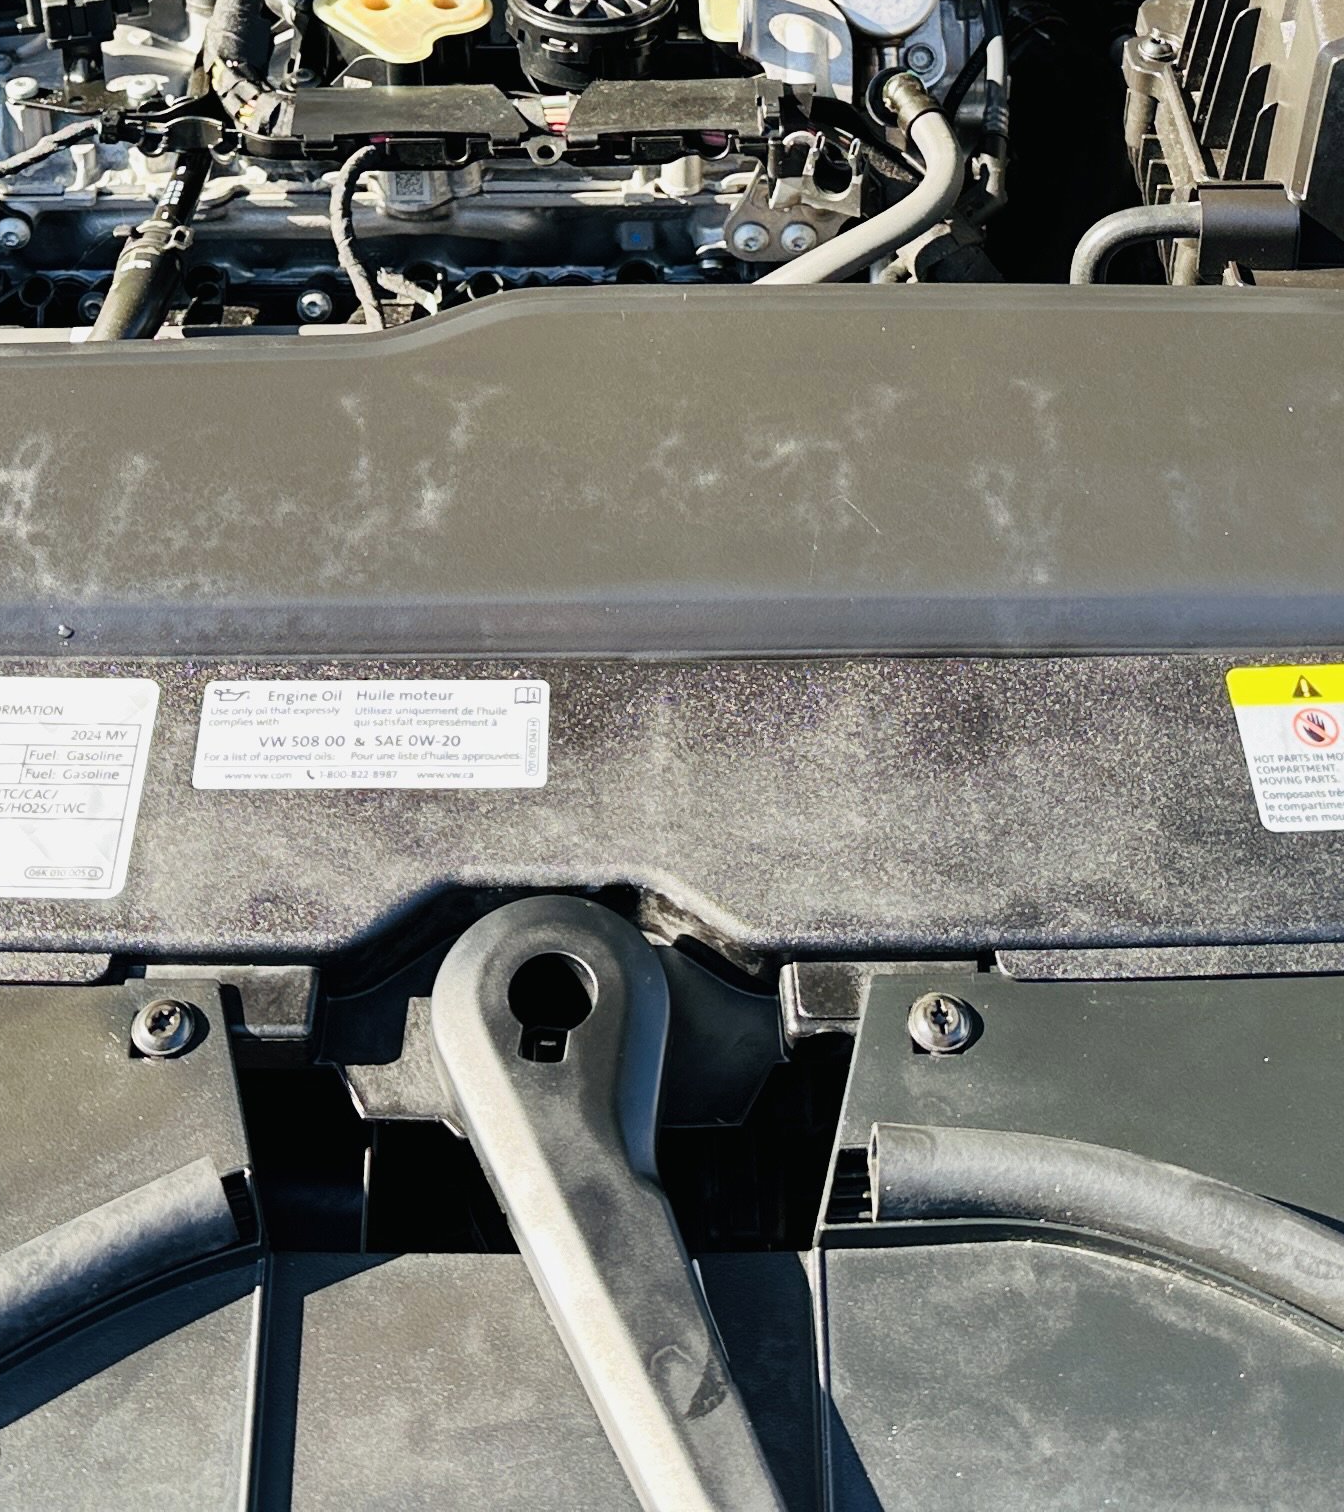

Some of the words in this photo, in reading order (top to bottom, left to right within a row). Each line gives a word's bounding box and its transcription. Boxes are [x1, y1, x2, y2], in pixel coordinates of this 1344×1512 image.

[268, 690, 317, 705] Engine
[322, 690, 342, 701] Oil
[356, 690, 395, 701] Huile
[399, 690, 454, 701] moteur
[232, 708, 252, 716] only
[271, 707, 291, 715] that
[294, 707, 340, 716] expressly
[355, 707, 393, 716] Utilisez
[395, 707, 458, 717] uniquement
[461, 707, 474, 716] de
[209, 719, 253, 727] complies
[354, 719, 370, 727] qui
[373, 718, 413, 727] satisfait
[491, 718, 497, 727] à
[71, 730, 101, 741] 2024
[106, 730, 127, 741] MY
[259, 737, 287, 747] VW
[292, 736, 320, 747] 508
[325, 736, 345, 747] 00
[354, 738, 366, 746] &
[375, 735, 403, 746] SAE
[408, 735, 461, 747] 0W-20
[29, 750, 58, 760] Fuel:
[67, 750, 123, 761] Gasoline
[204, 753, 220, 761] For
[232, 752, 247, 761] list
[250, 752, 261, 761] of
[263, 752, 311, 764] approved
[351, 752, 374, 760] Pour
[398, 752, 419, 760] liste
[1254, 755, 1274, 764] HOT
[1278, 753, 1311, 763] PARTS
[1313, 753, 1324, 761] IN
[25, 769, 55, 779] Fuel:
[63, 769, 119, 780] Gasoline
[1259, 775, 1302, 785] MOVING
[1263, 789, 1326, 801] Composants
[1265, 802, 1276, 811] le
[1306, 814, 1318, 822] en
